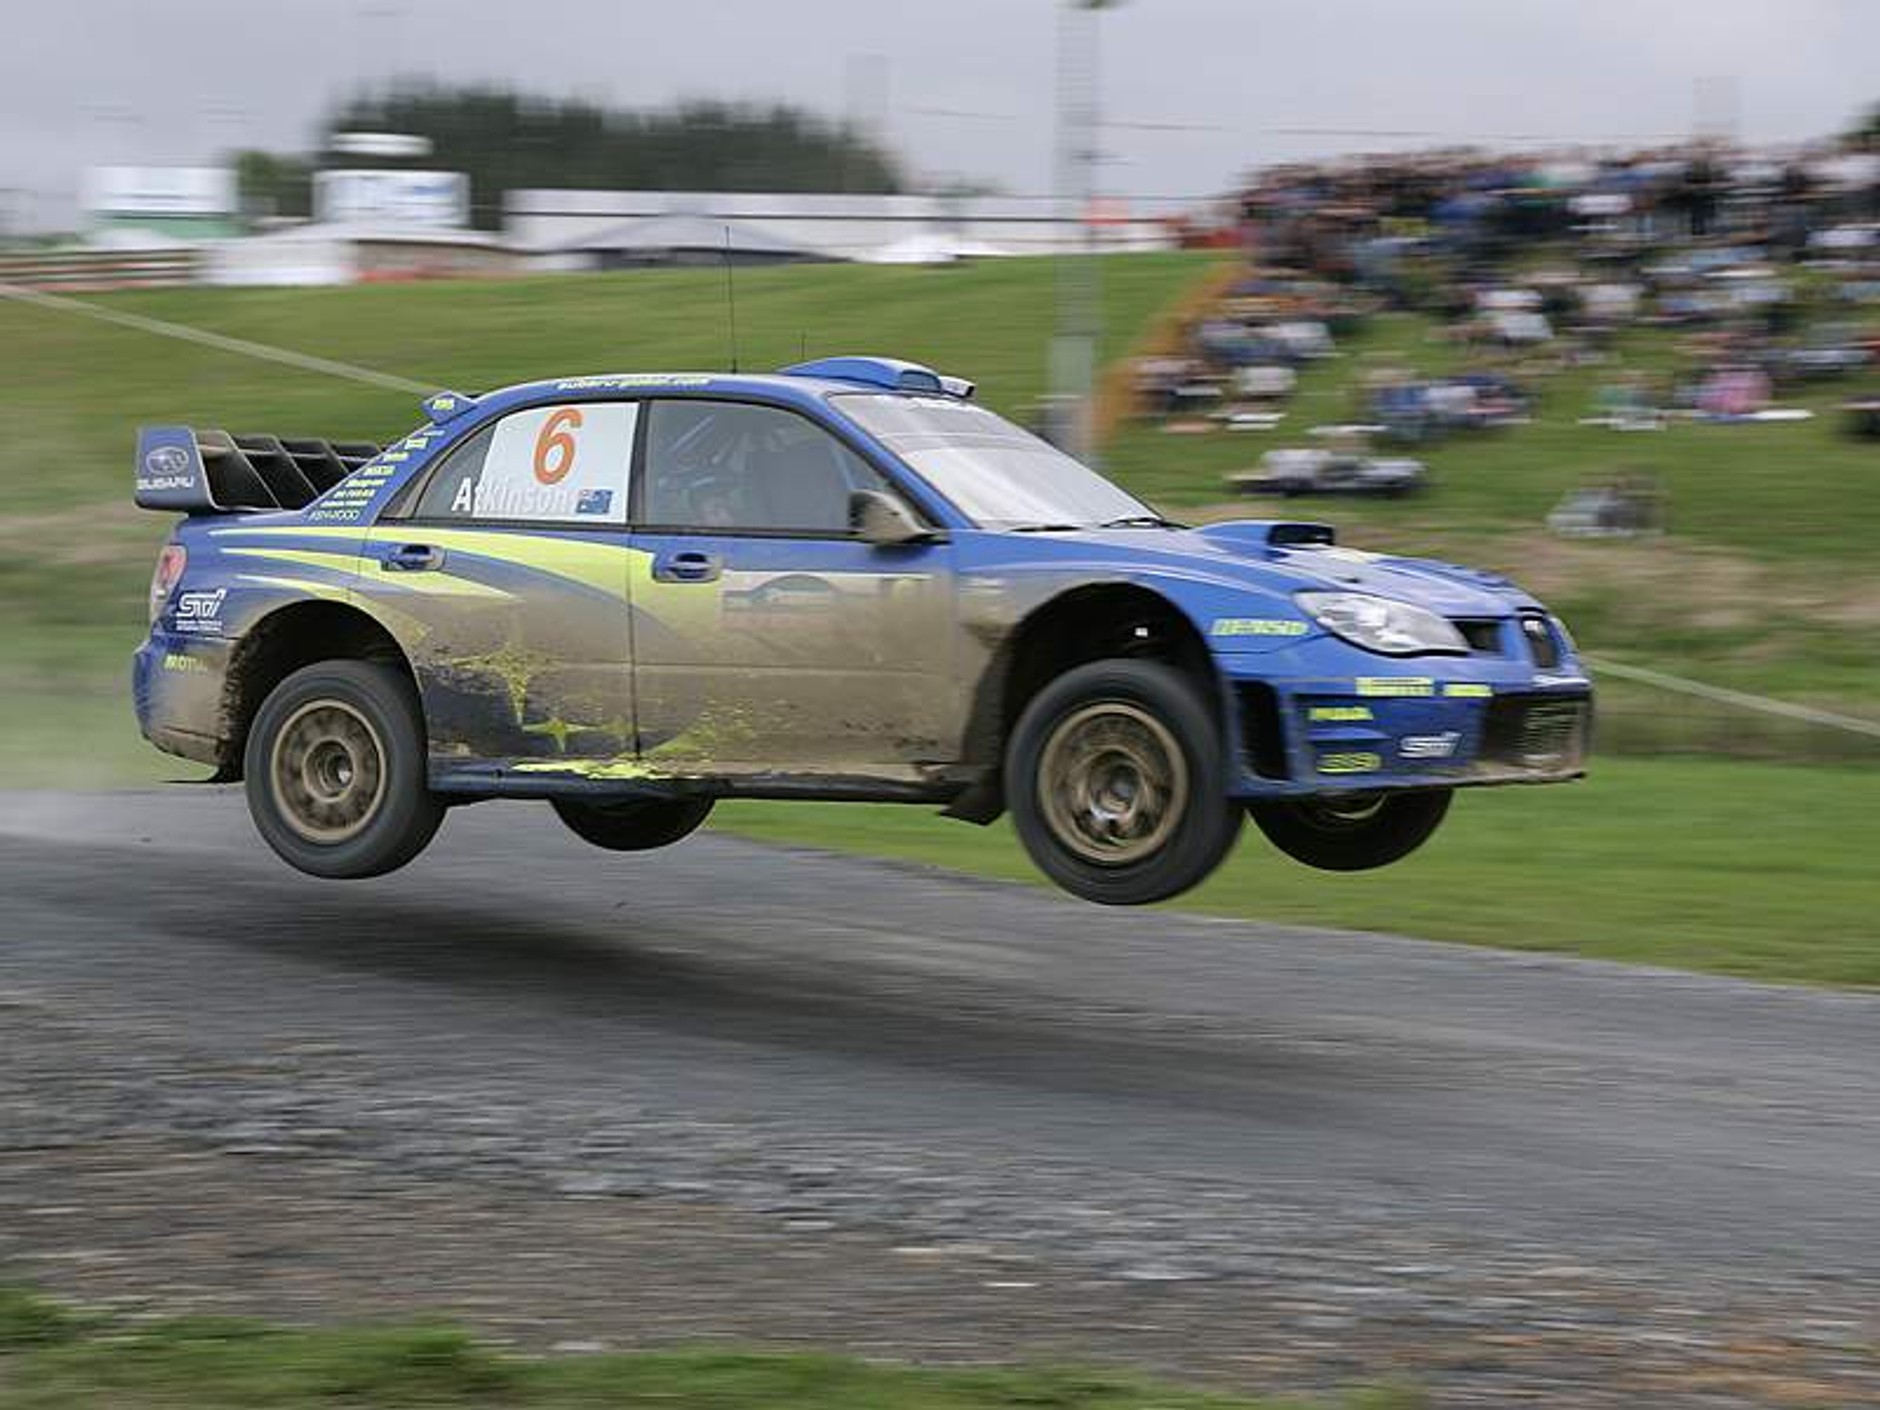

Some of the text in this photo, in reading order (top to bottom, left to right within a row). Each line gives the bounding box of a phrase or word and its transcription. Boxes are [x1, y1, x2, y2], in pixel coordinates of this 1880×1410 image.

[533, 408, 583, 485] 6
[136, 476, 195, 490] SUBARU
[451, 475, 571, 516] Atkinson
[163, 654, 209, 672] MOT
